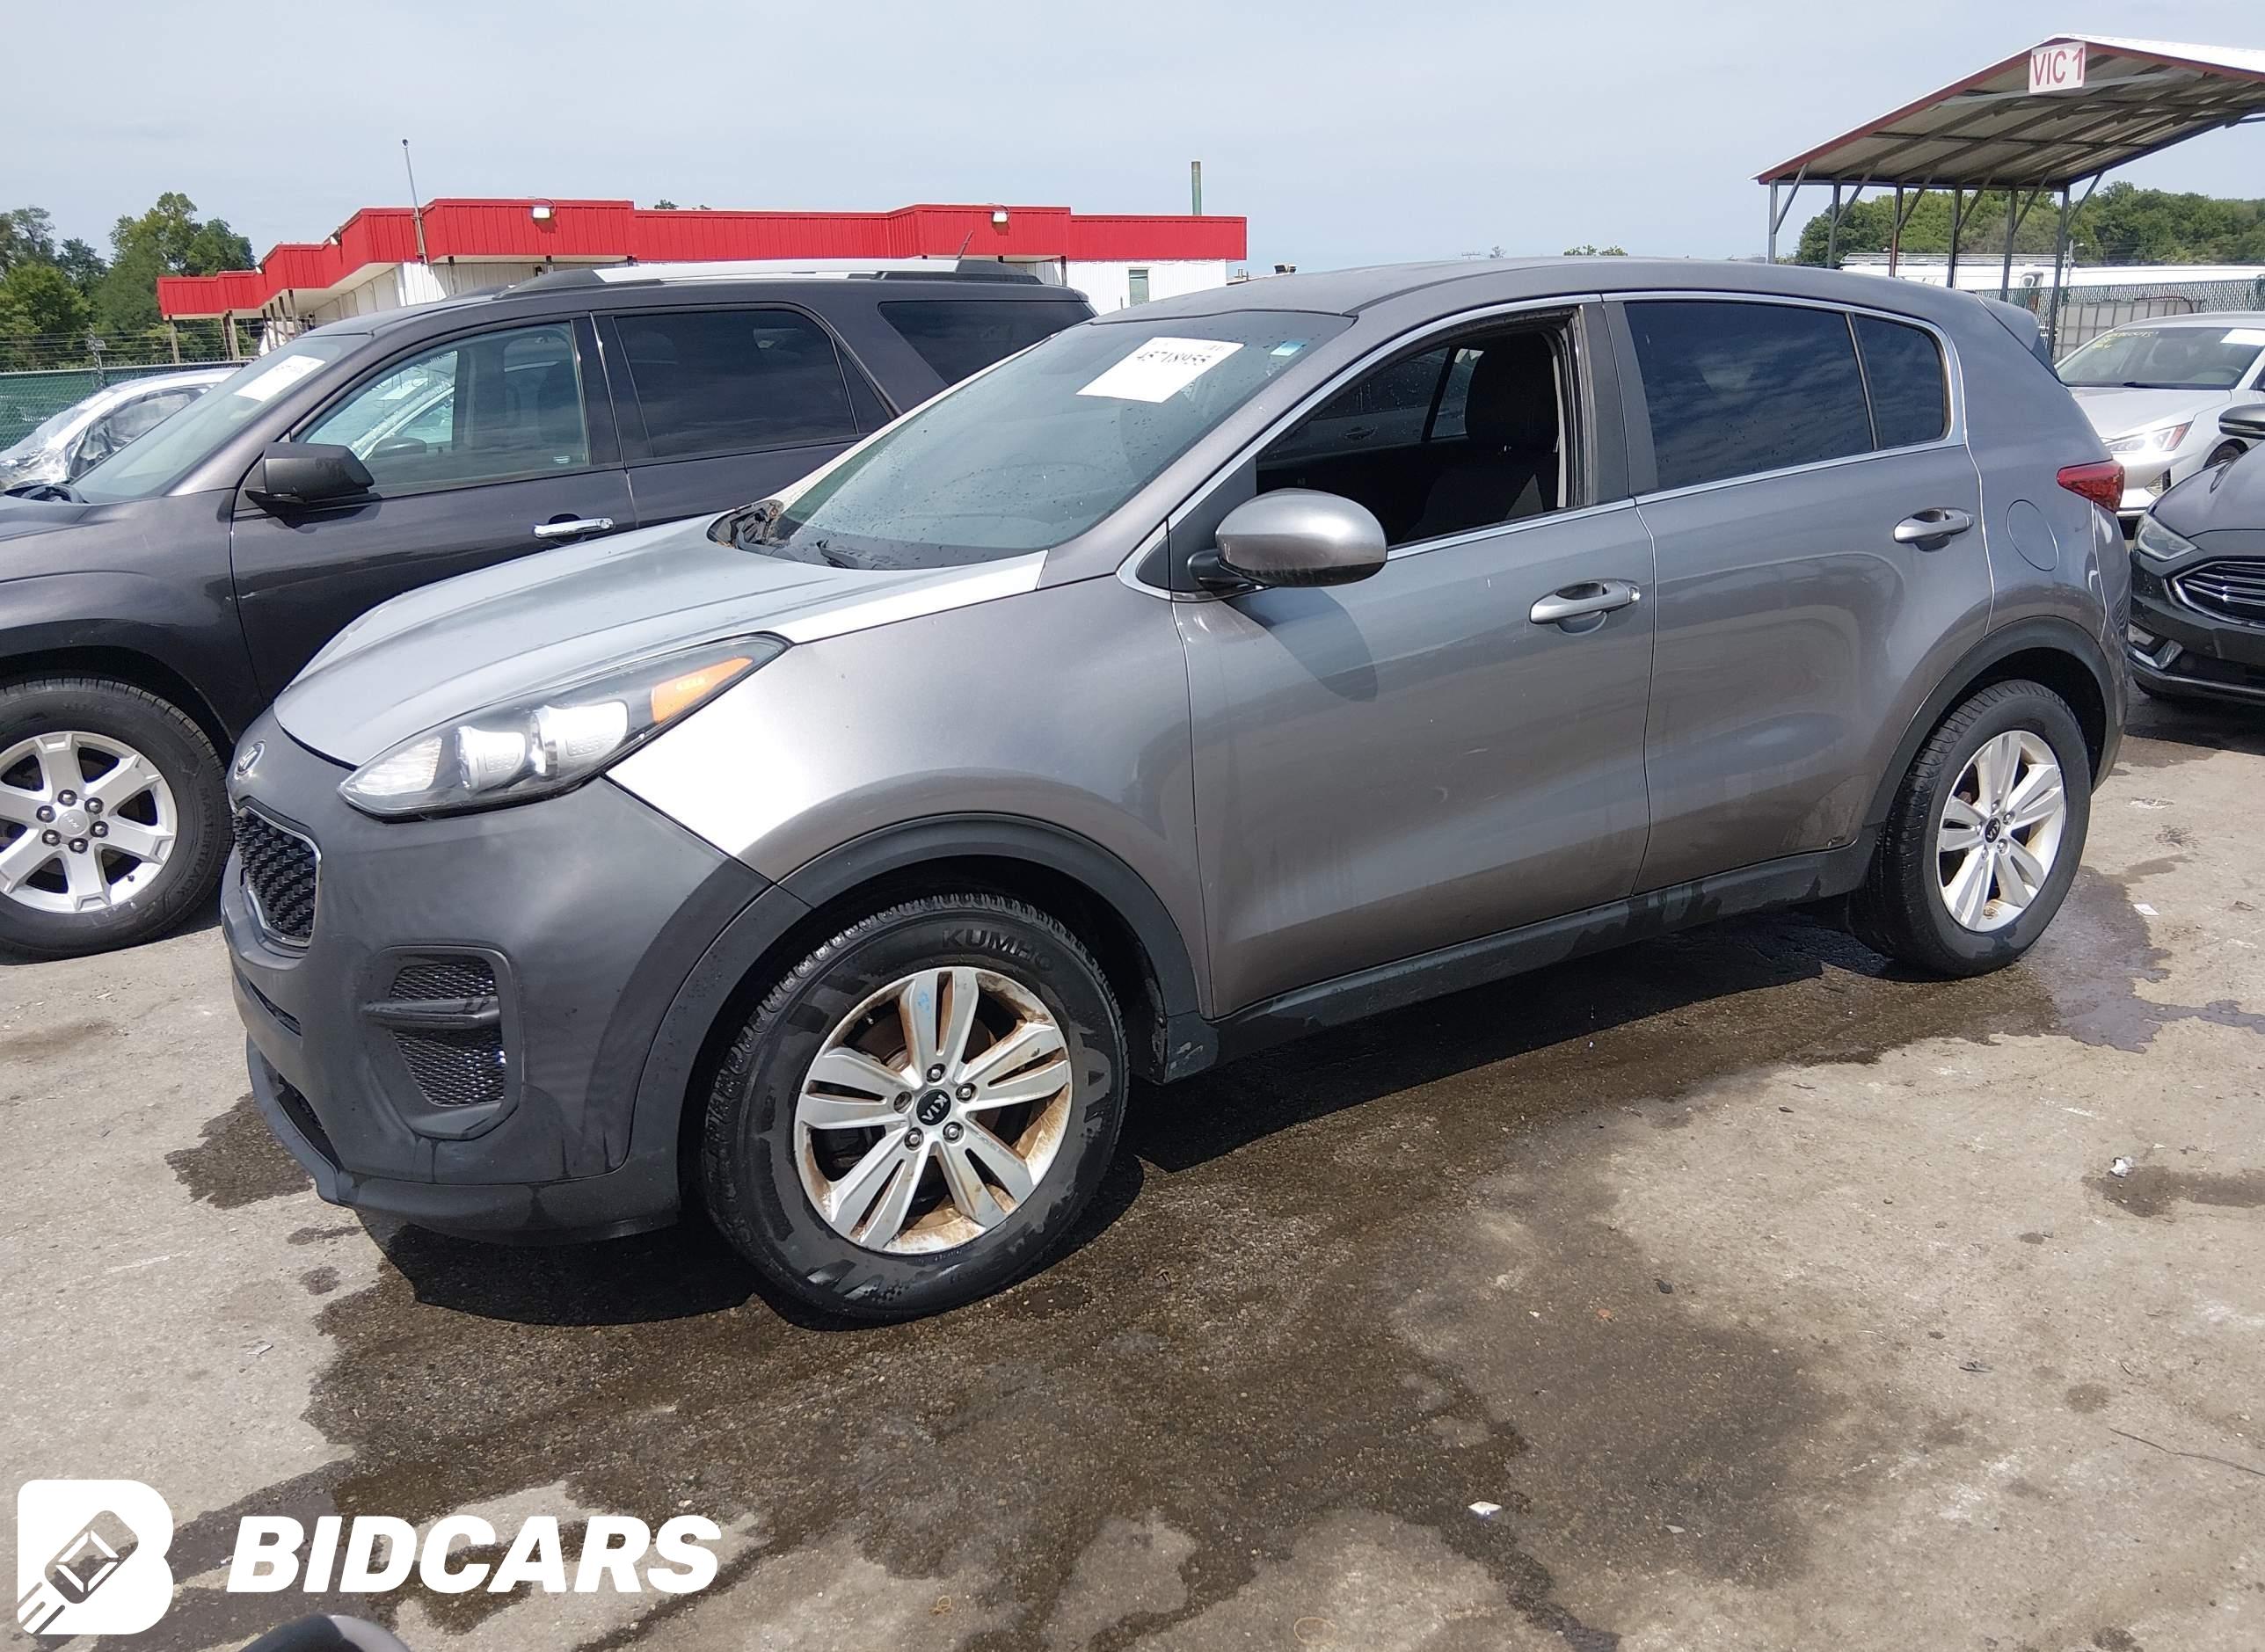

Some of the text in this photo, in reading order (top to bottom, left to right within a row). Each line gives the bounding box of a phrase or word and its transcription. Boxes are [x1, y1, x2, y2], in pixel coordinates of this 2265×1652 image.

[2032, 47, 2084, 86] VIC 1
[921, 1094, 949, 1121] KIA
